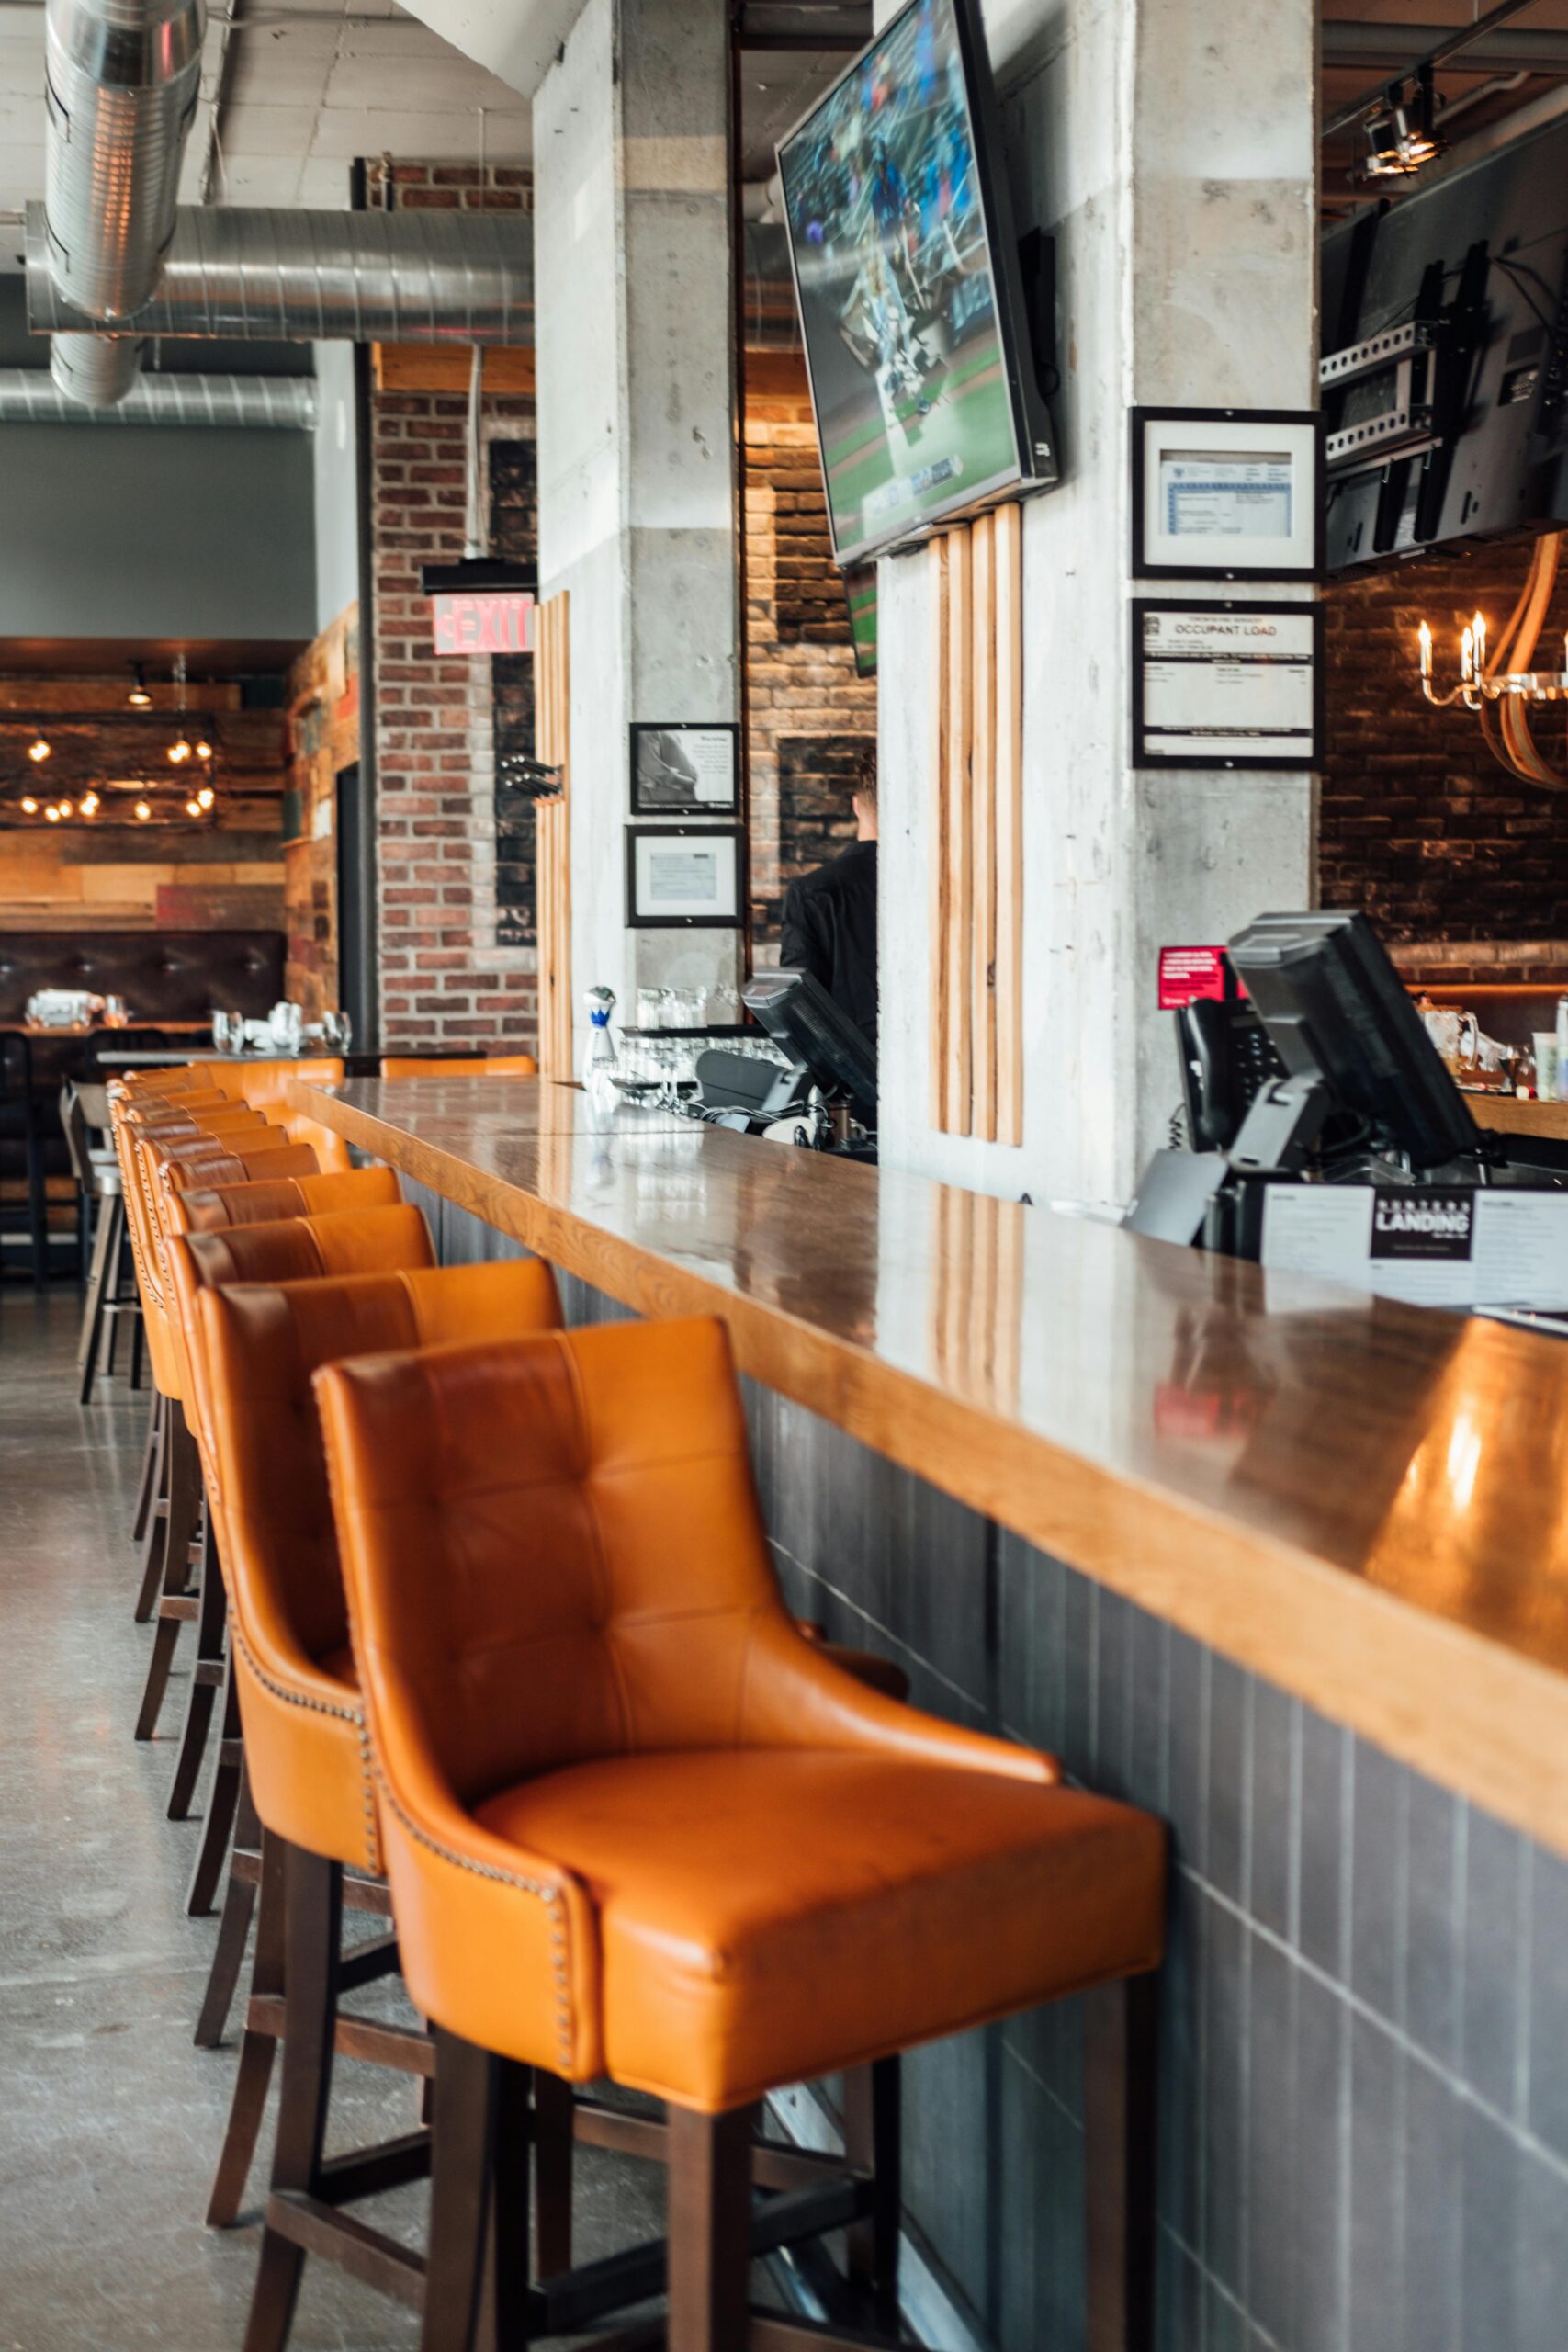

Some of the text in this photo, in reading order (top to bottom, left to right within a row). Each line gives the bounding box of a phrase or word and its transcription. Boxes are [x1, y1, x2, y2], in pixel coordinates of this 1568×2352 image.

[453, 599, 530, 649] EXIT
[1175, 625, 1277, 636] OCCUPANT LOAD
[1376, 1211, 1469, 1233] LANDING
